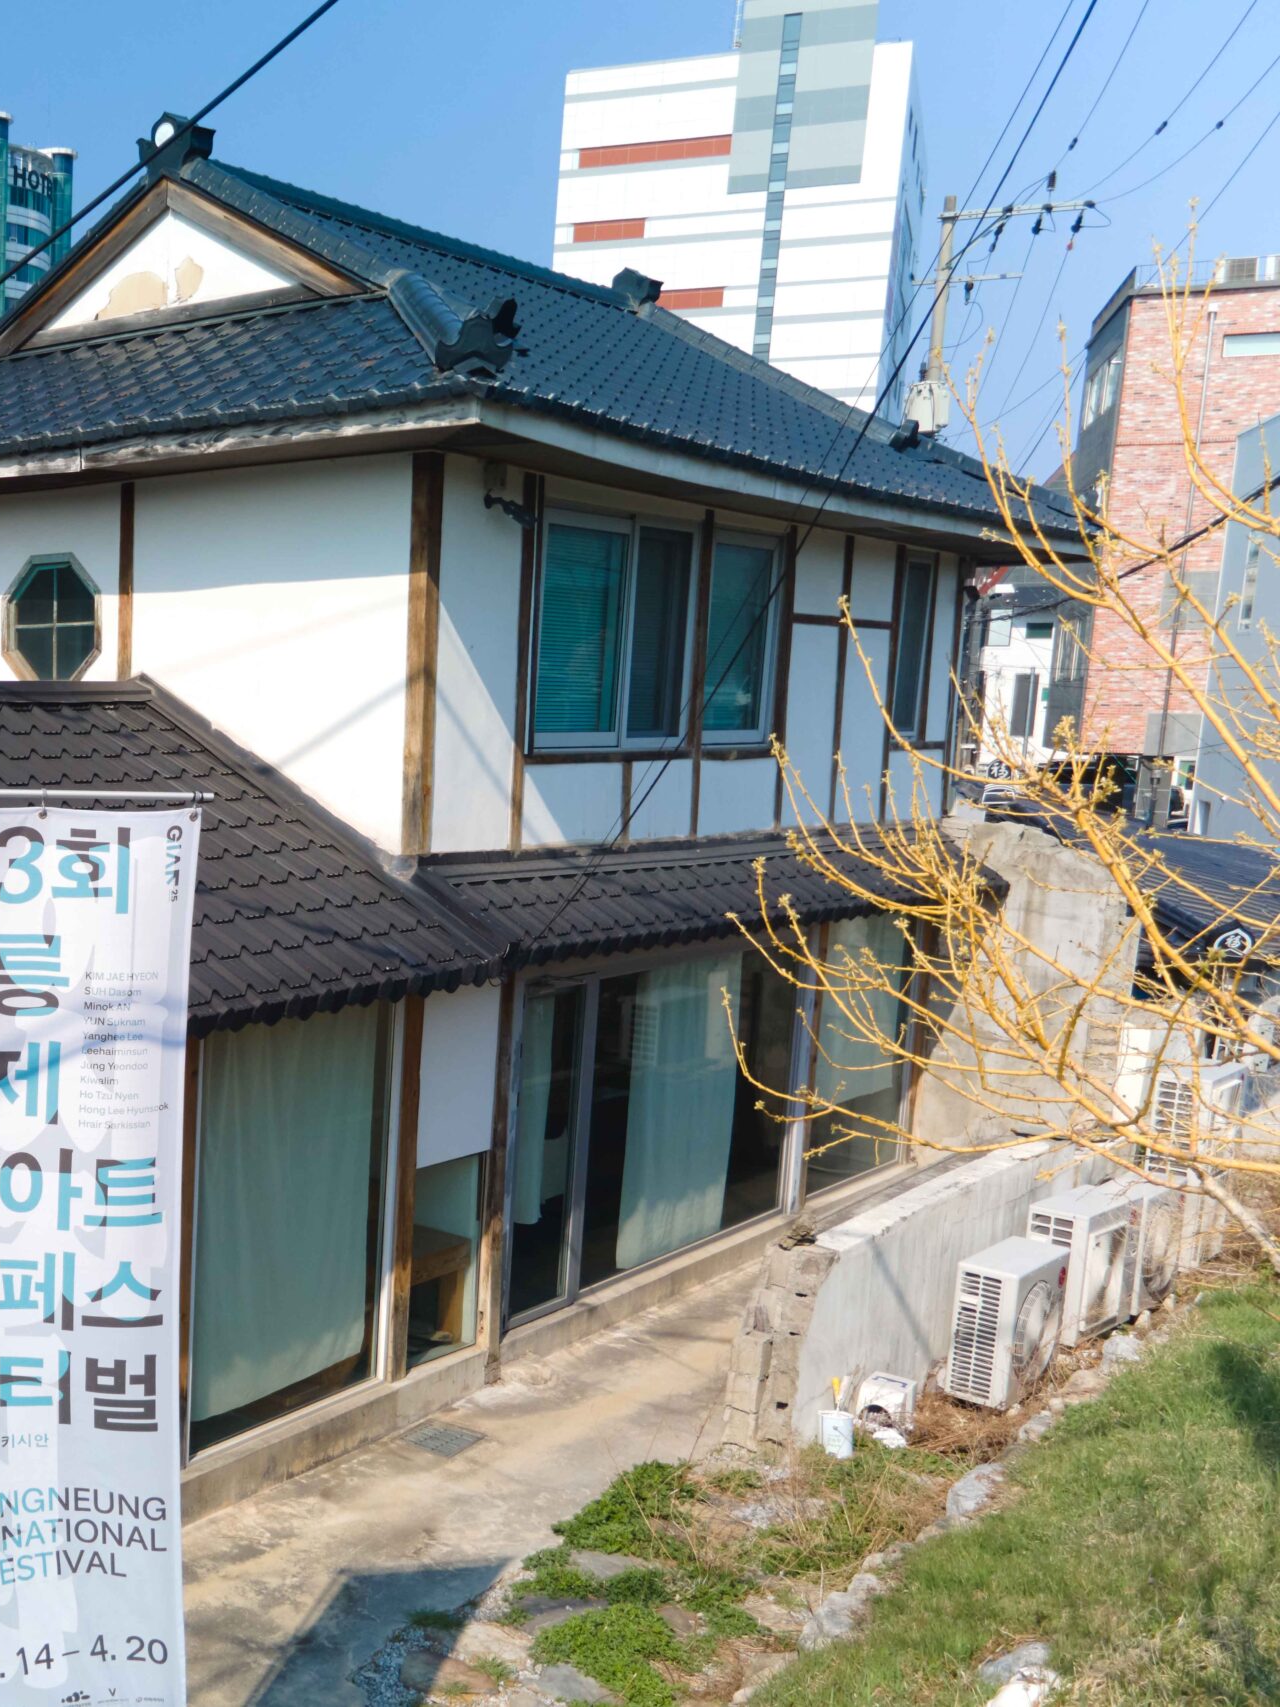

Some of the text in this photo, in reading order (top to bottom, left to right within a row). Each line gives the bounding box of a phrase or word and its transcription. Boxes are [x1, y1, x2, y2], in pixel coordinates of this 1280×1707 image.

[85, 971, 104, 980] KIM
[83, 1001, 114, 1011] Minok
[82, 1031, 125, 1042] Yanghee
[80, 1062, 106, 1072] Jung
[79, 1104, 106, 1116] Hong
